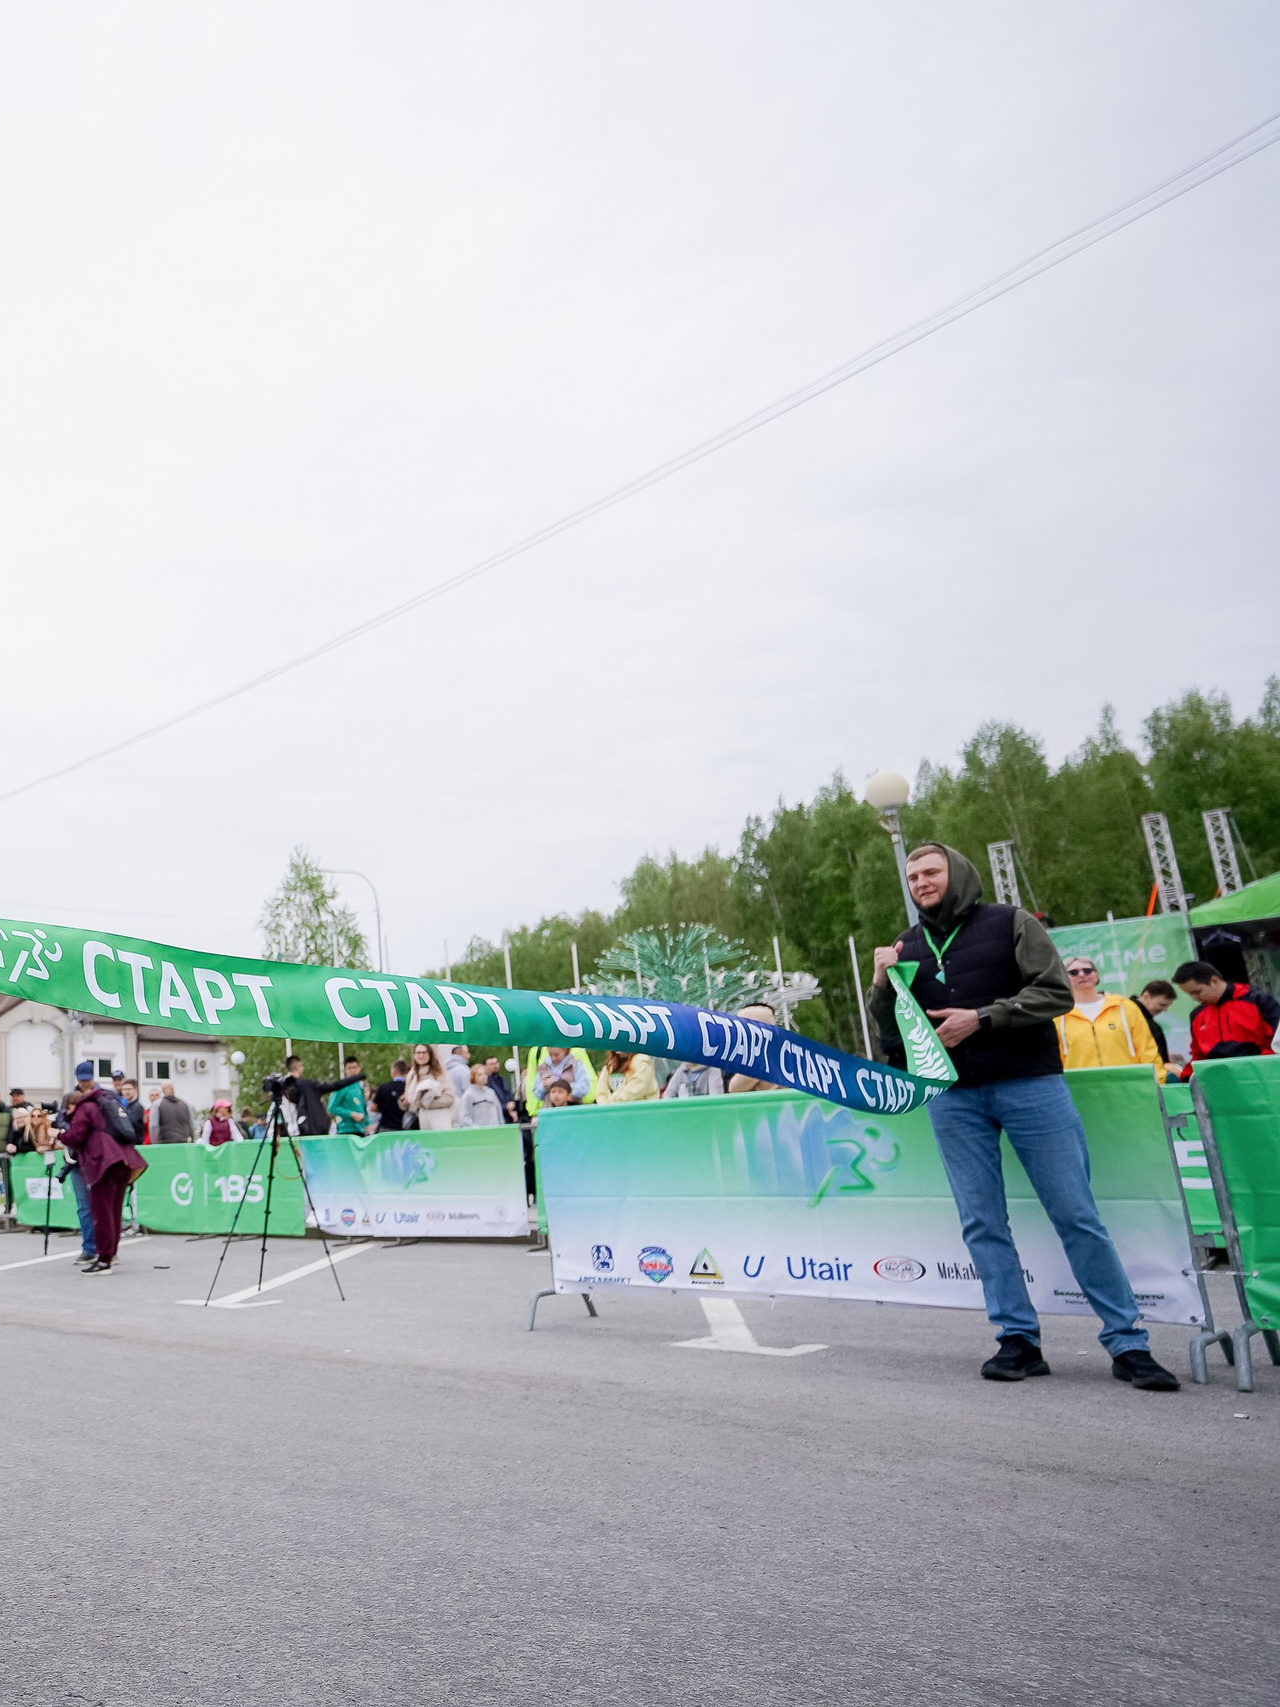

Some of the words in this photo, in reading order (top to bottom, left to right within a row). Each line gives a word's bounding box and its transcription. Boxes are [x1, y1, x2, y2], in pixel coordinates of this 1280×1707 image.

[82, 940, 275, 1029] СТАРТ
[323, 976, 510, 1035] СТАРТ
[538, 995, 675, 1050] СТАРТ
[697, 1011, 773, 1074] СТАРТ
[779, 1040, 848, 1099] СТАРТ
[856, 1068, 916, 1114] СТАРТ
[214, 1174, 265, 1203] 185
[786, 1255, 853, 1281] Utair
